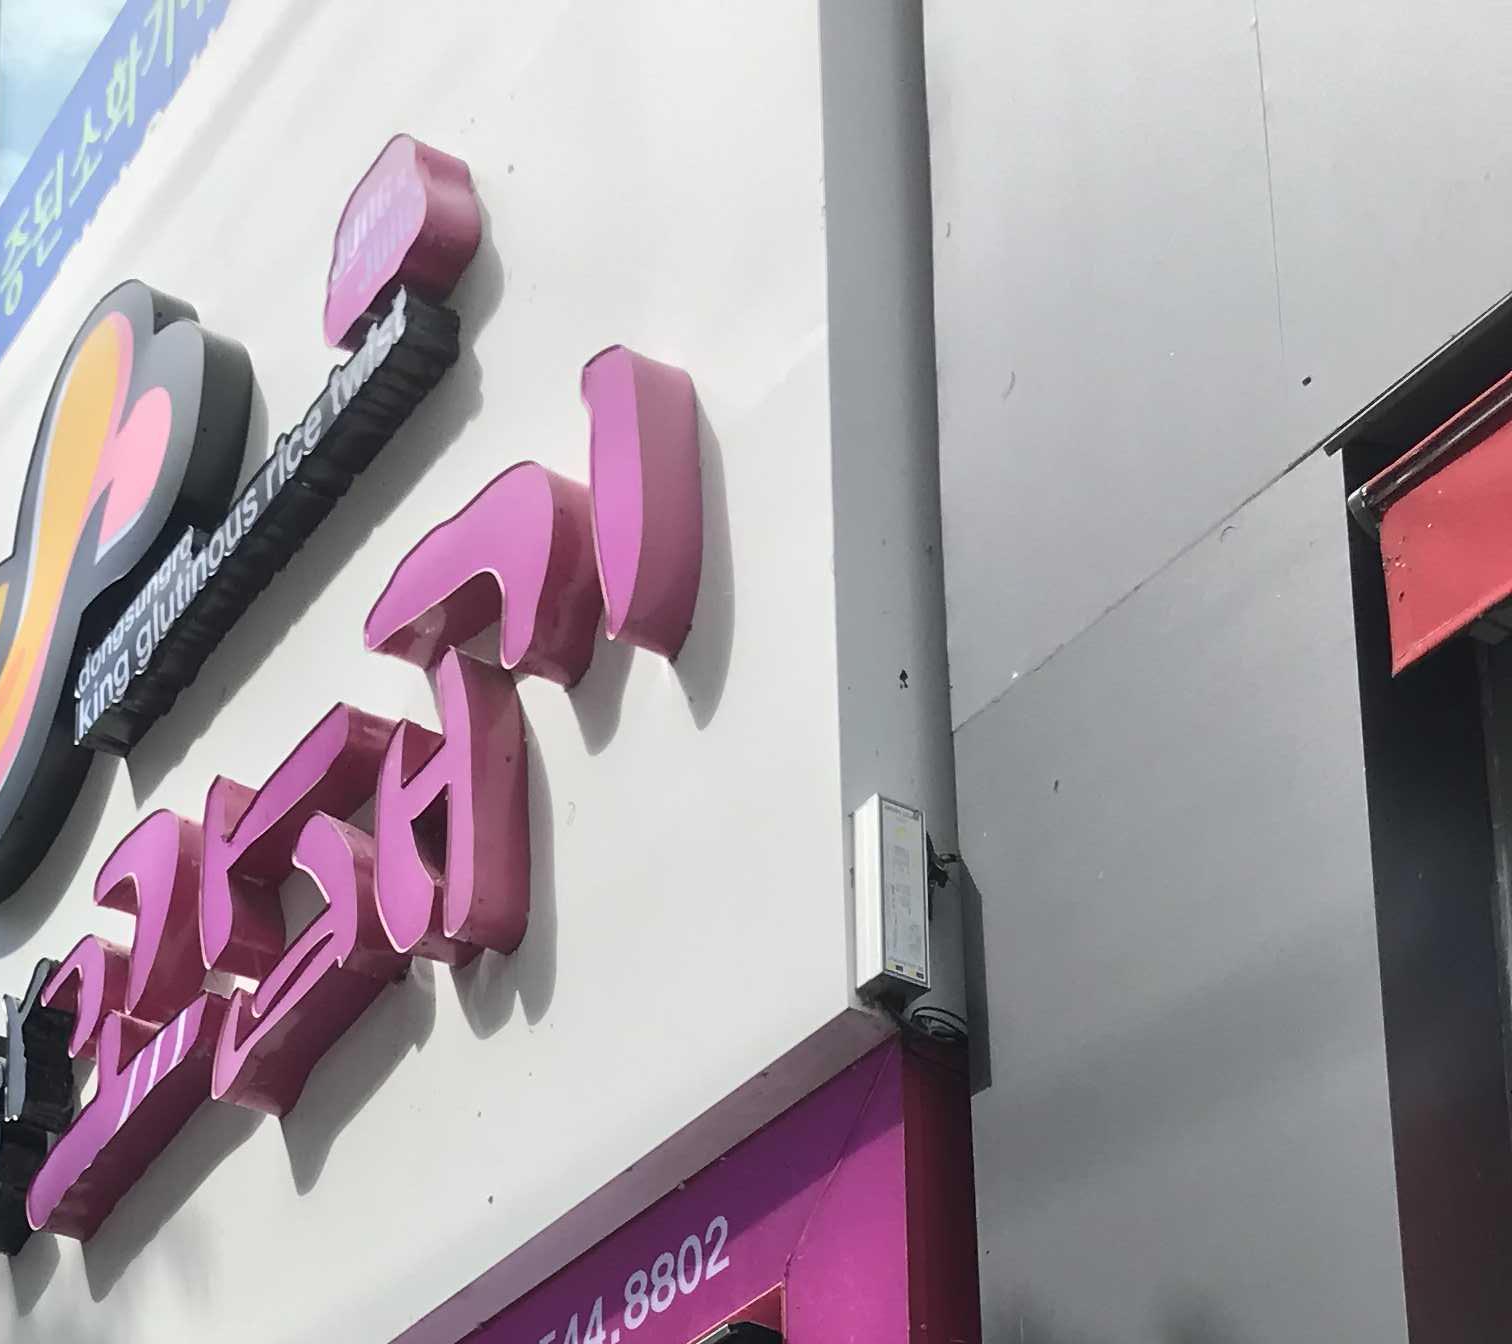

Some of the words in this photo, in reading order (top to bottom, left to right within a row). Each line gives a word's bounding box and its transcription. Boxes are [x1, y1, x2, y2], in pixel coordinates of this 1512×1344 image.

[25, 344, 703, 1235] 꽈배기
[75, 655, 131, 748] king
[133, 485, 260, 678] glutinous
[265, 408, 323, 508] rice
[329, 283, 408, 420] twist
